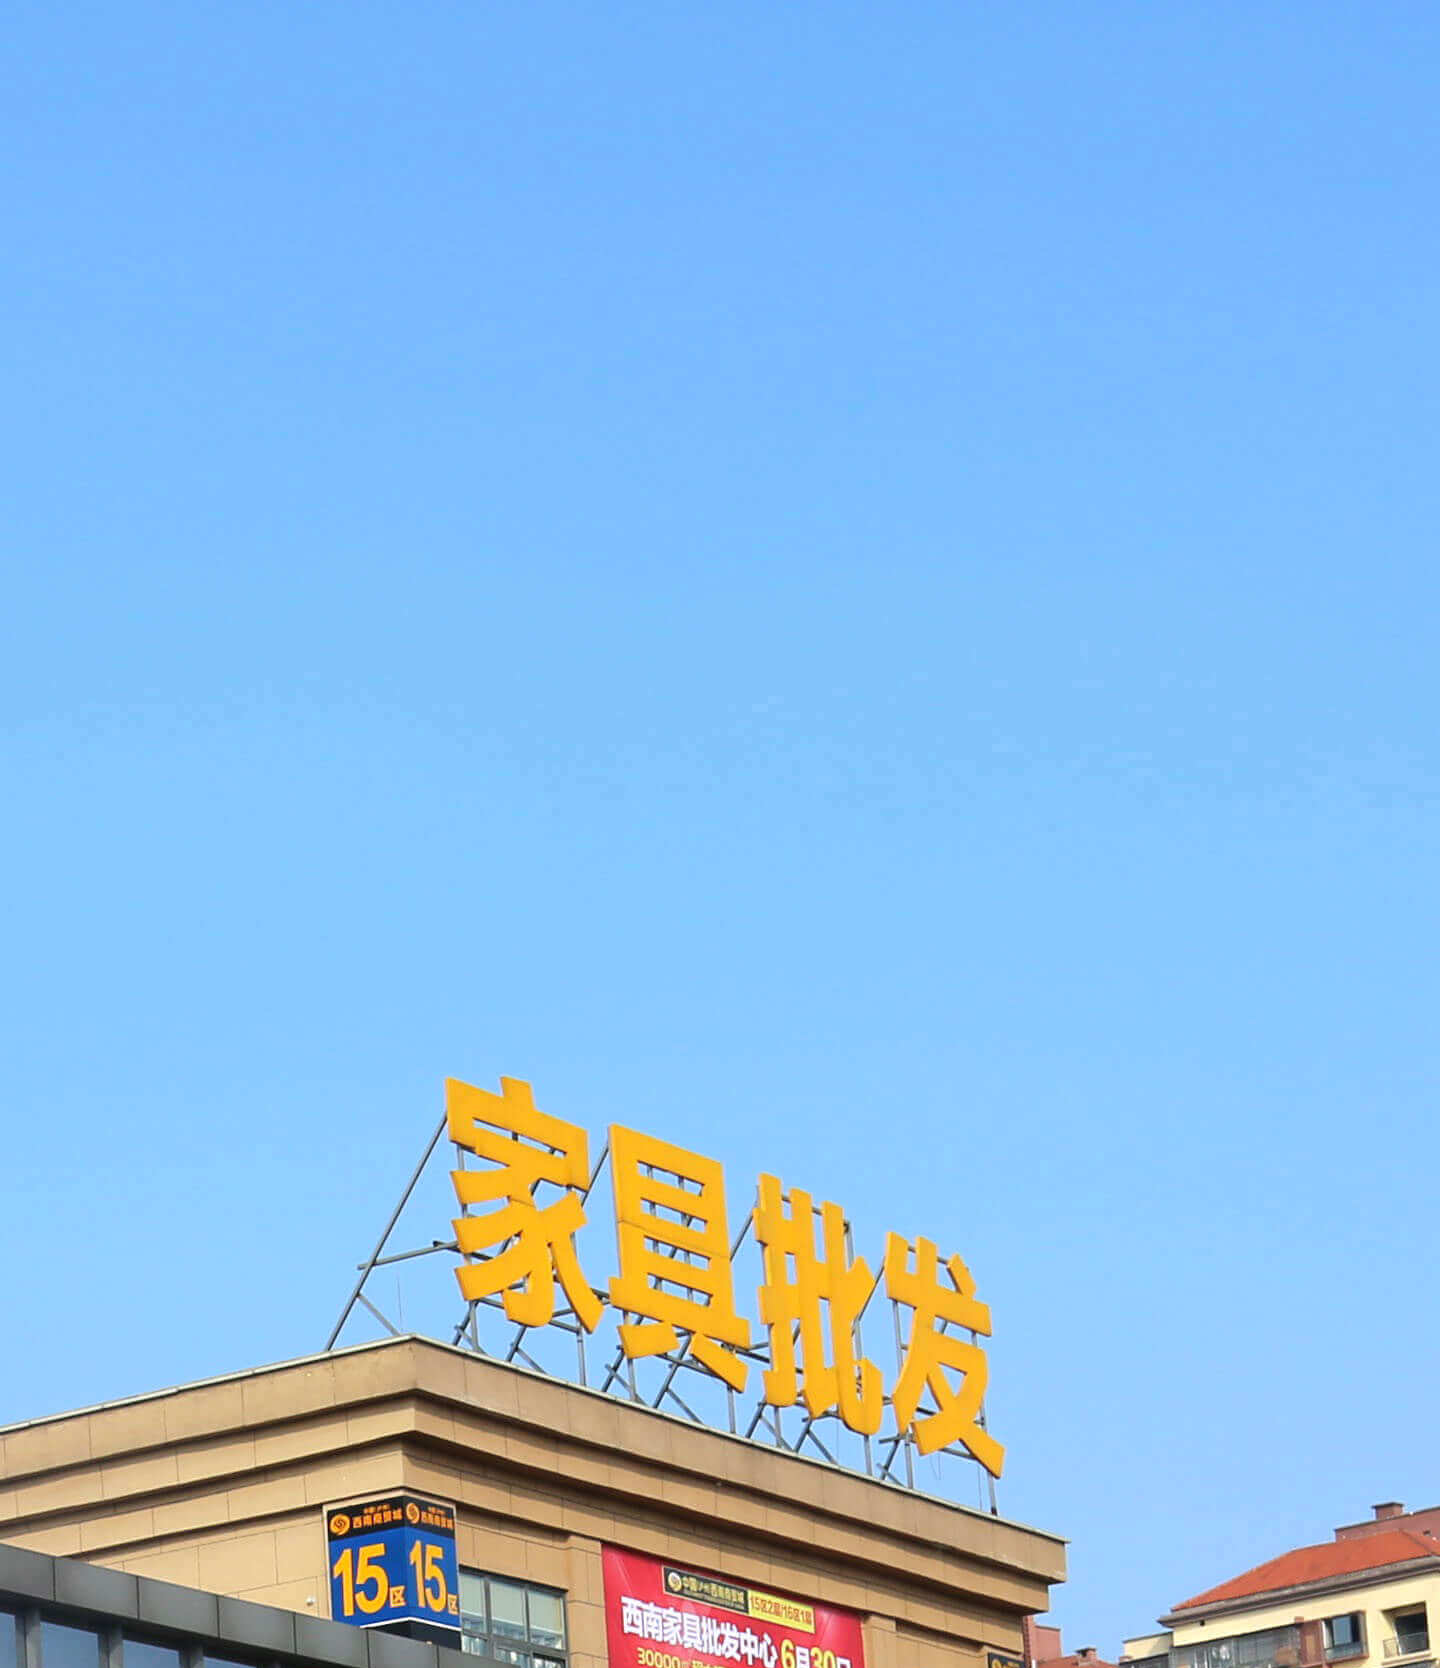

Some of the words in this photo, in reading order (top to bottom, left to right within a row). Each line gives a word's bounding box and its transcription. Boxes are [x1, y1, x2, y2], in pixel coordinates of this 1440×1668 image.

[445, 1075, 1005, 1479] 家具批发
[333, 1543, 405, 1616] 15区
[410, 1540, 459, 1615] 15区
[621, 1596, 777, 1668] 西南家具批发中心
